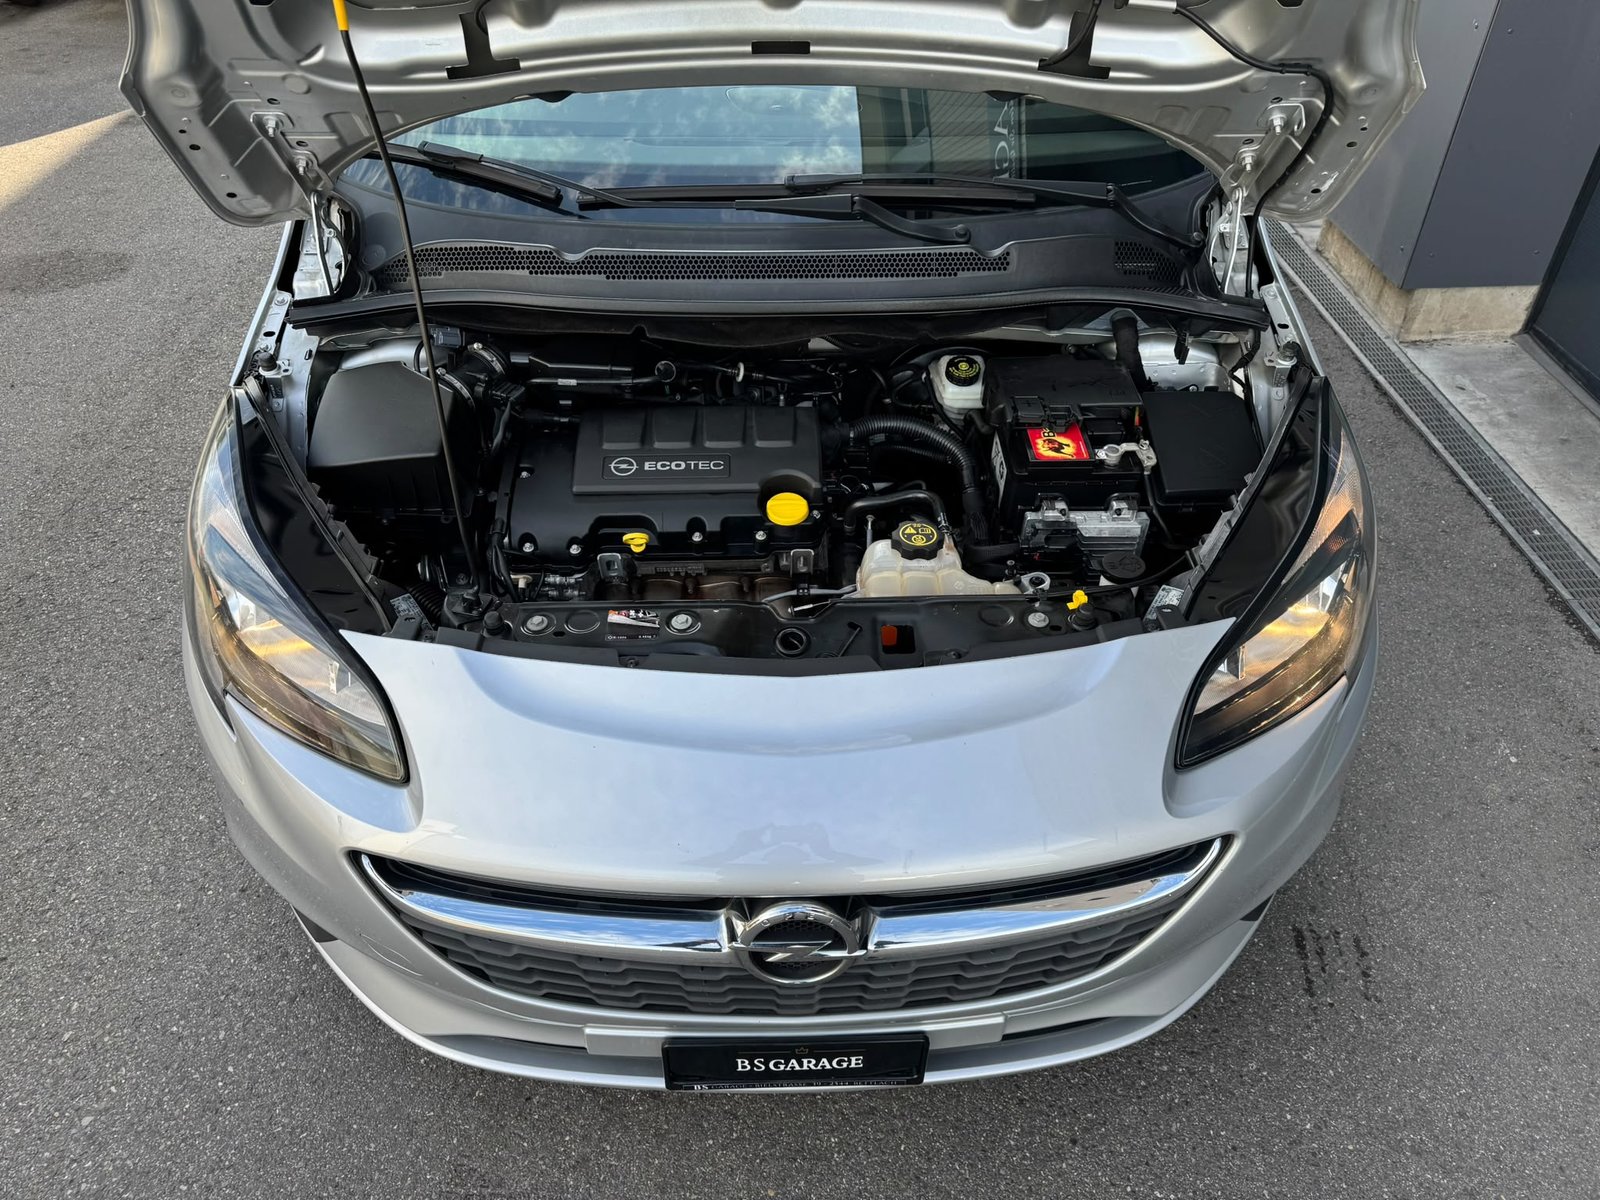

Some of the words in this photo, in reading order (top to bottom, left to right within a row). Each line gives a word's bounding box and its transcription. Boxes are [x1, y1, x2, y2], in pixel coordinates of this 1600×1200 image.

[644, 461, 724, 470] ECOTEC
[736, 1058, 766, 1071] BS
[769, 1056, 864, 1070] GARAGE
